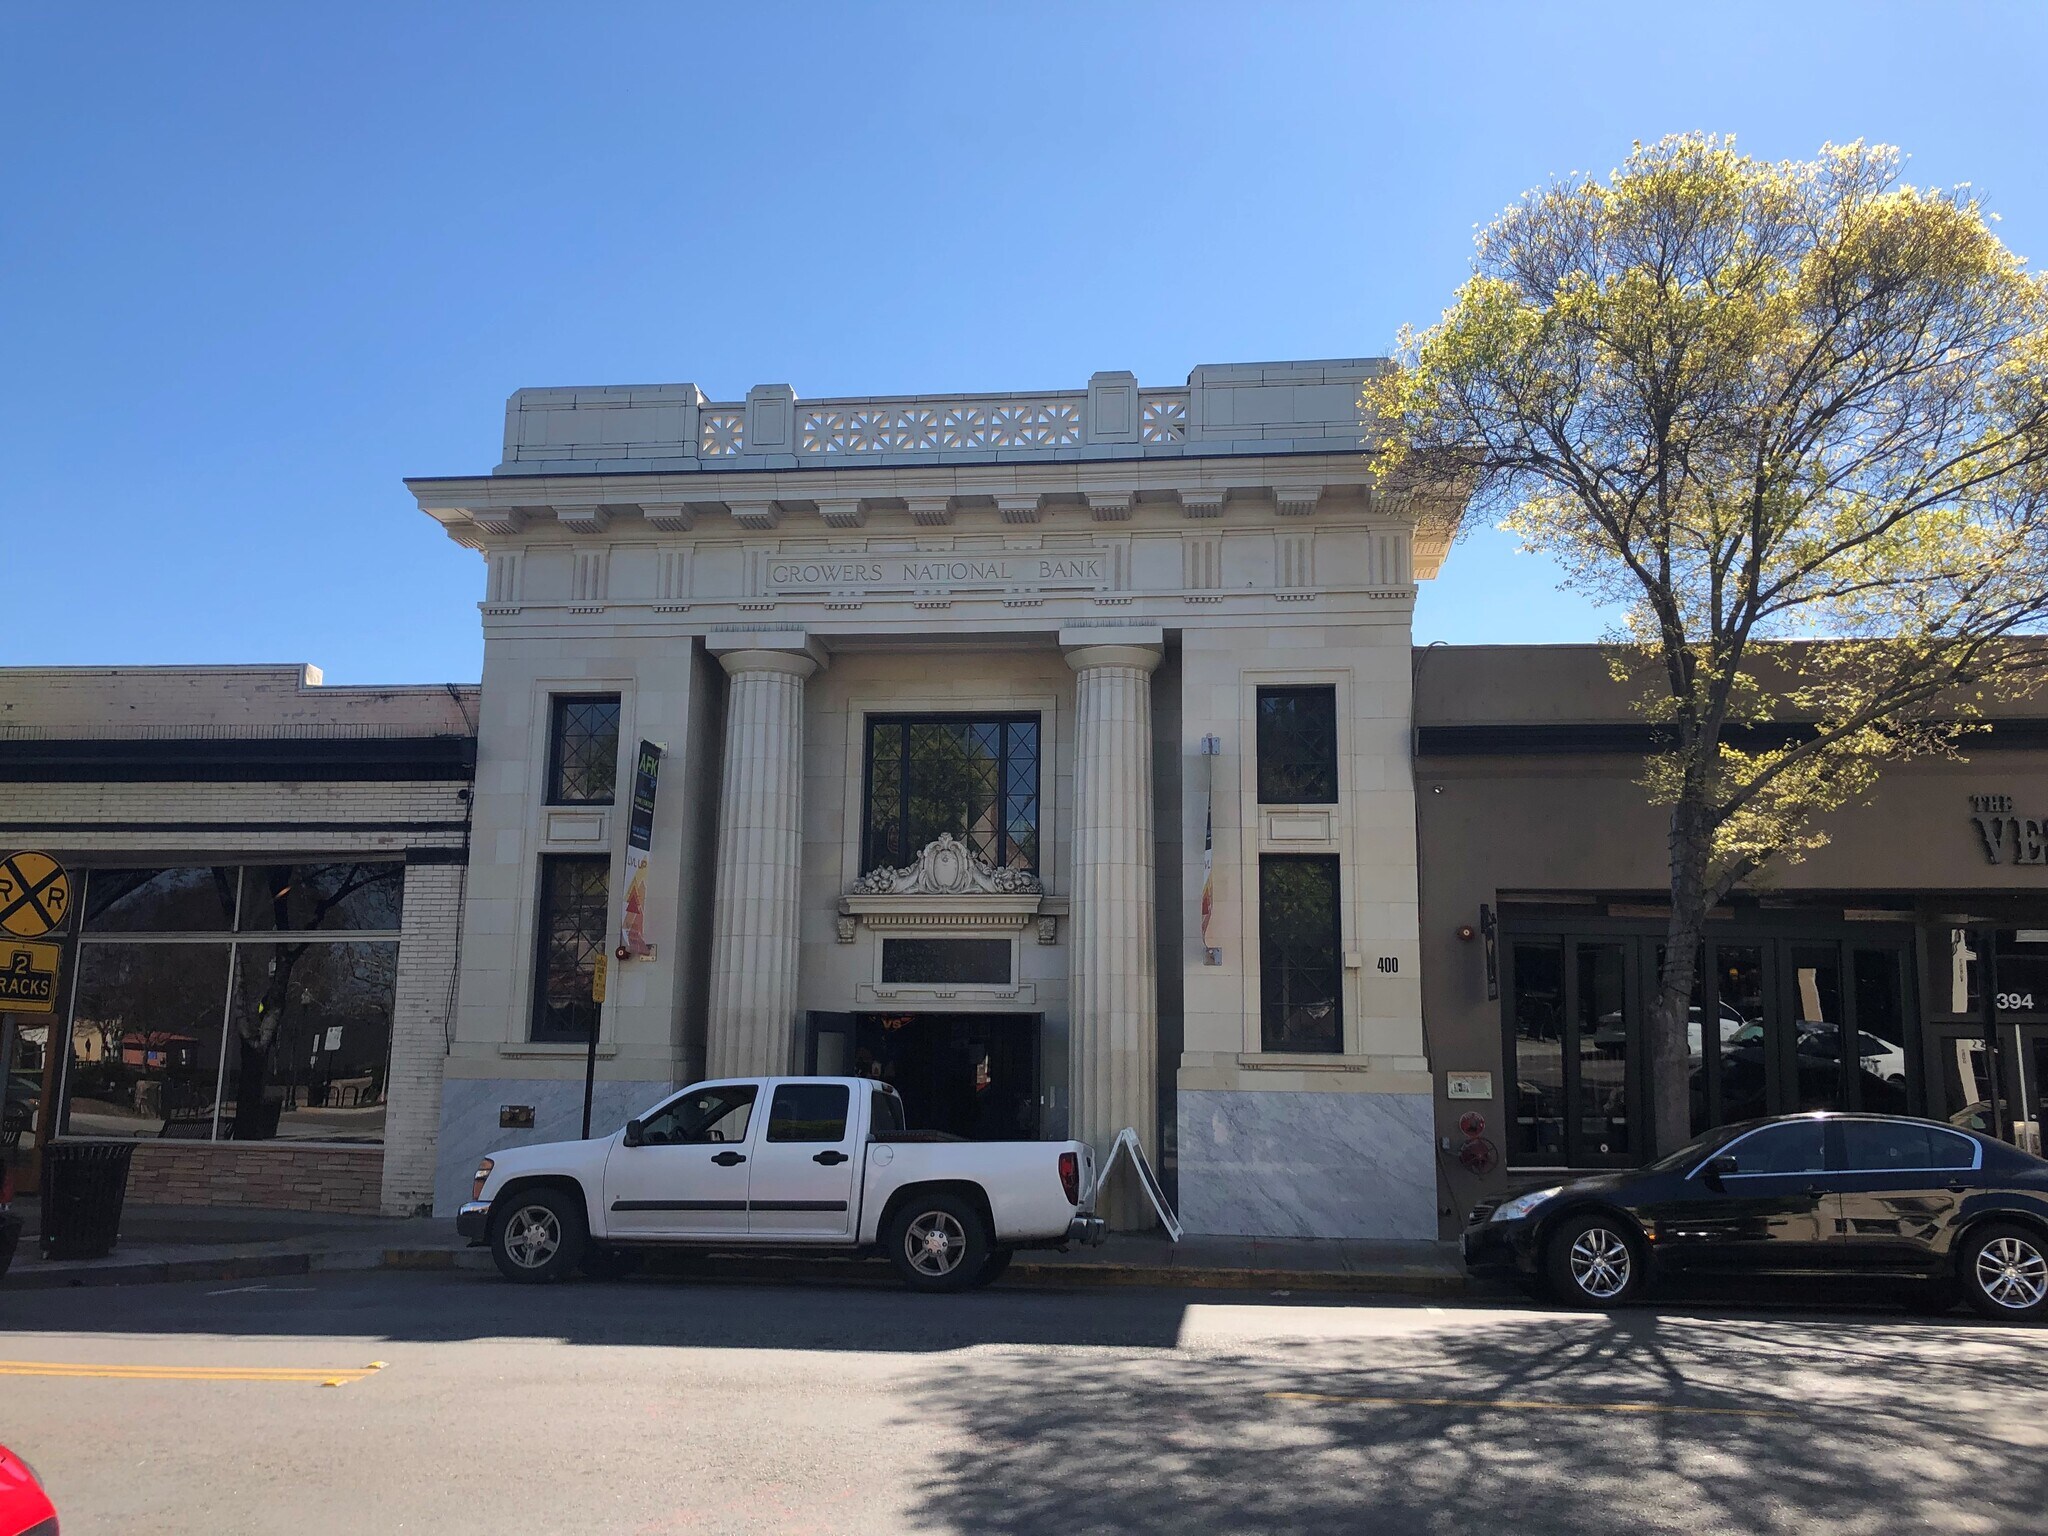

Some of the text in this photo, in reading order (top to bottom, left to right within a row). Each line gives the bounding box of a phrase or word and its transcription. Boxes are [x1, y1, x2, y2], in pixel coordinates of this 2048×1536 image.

[773, 560, 1099, 583] GROWERS NATIONAL BANK
[639, 753, 659, 778] AFK
[1969, 795, 2013, 812] THE
[1971, 817, 2048, 865] VE
[0, 879, 65, 910] R R
[14, 956, 27, 974] 2
[1377, 956, 1399, 973] 400
[0, 977, 49, 996] RACKS
[1996, 993, 2035, 1010] 394
